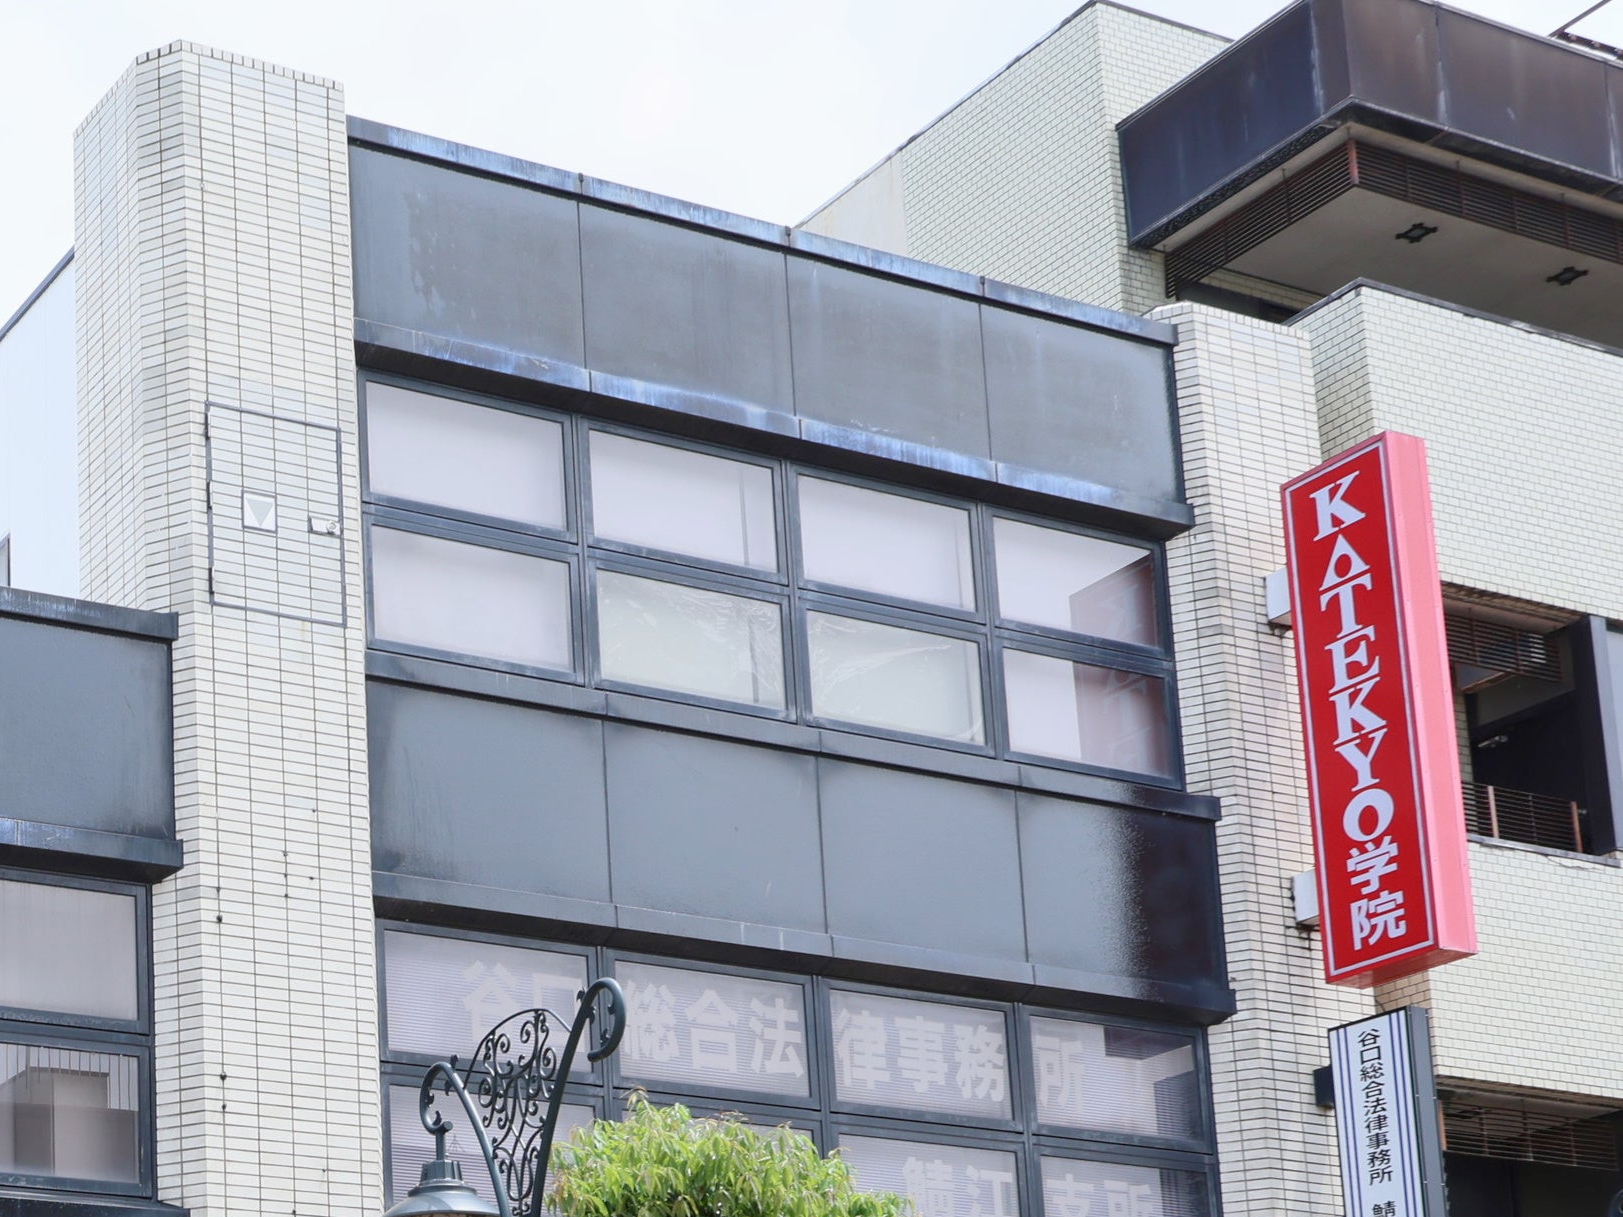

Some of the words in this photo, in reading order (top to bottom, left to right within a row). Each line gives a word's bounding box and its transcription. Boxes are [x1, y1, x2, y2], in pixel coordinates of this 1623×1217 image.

[1309, 469, 1407, 952] KATEKYO学院
[1357, 1028, 1394, 1187] 谷口総合法律事務所
